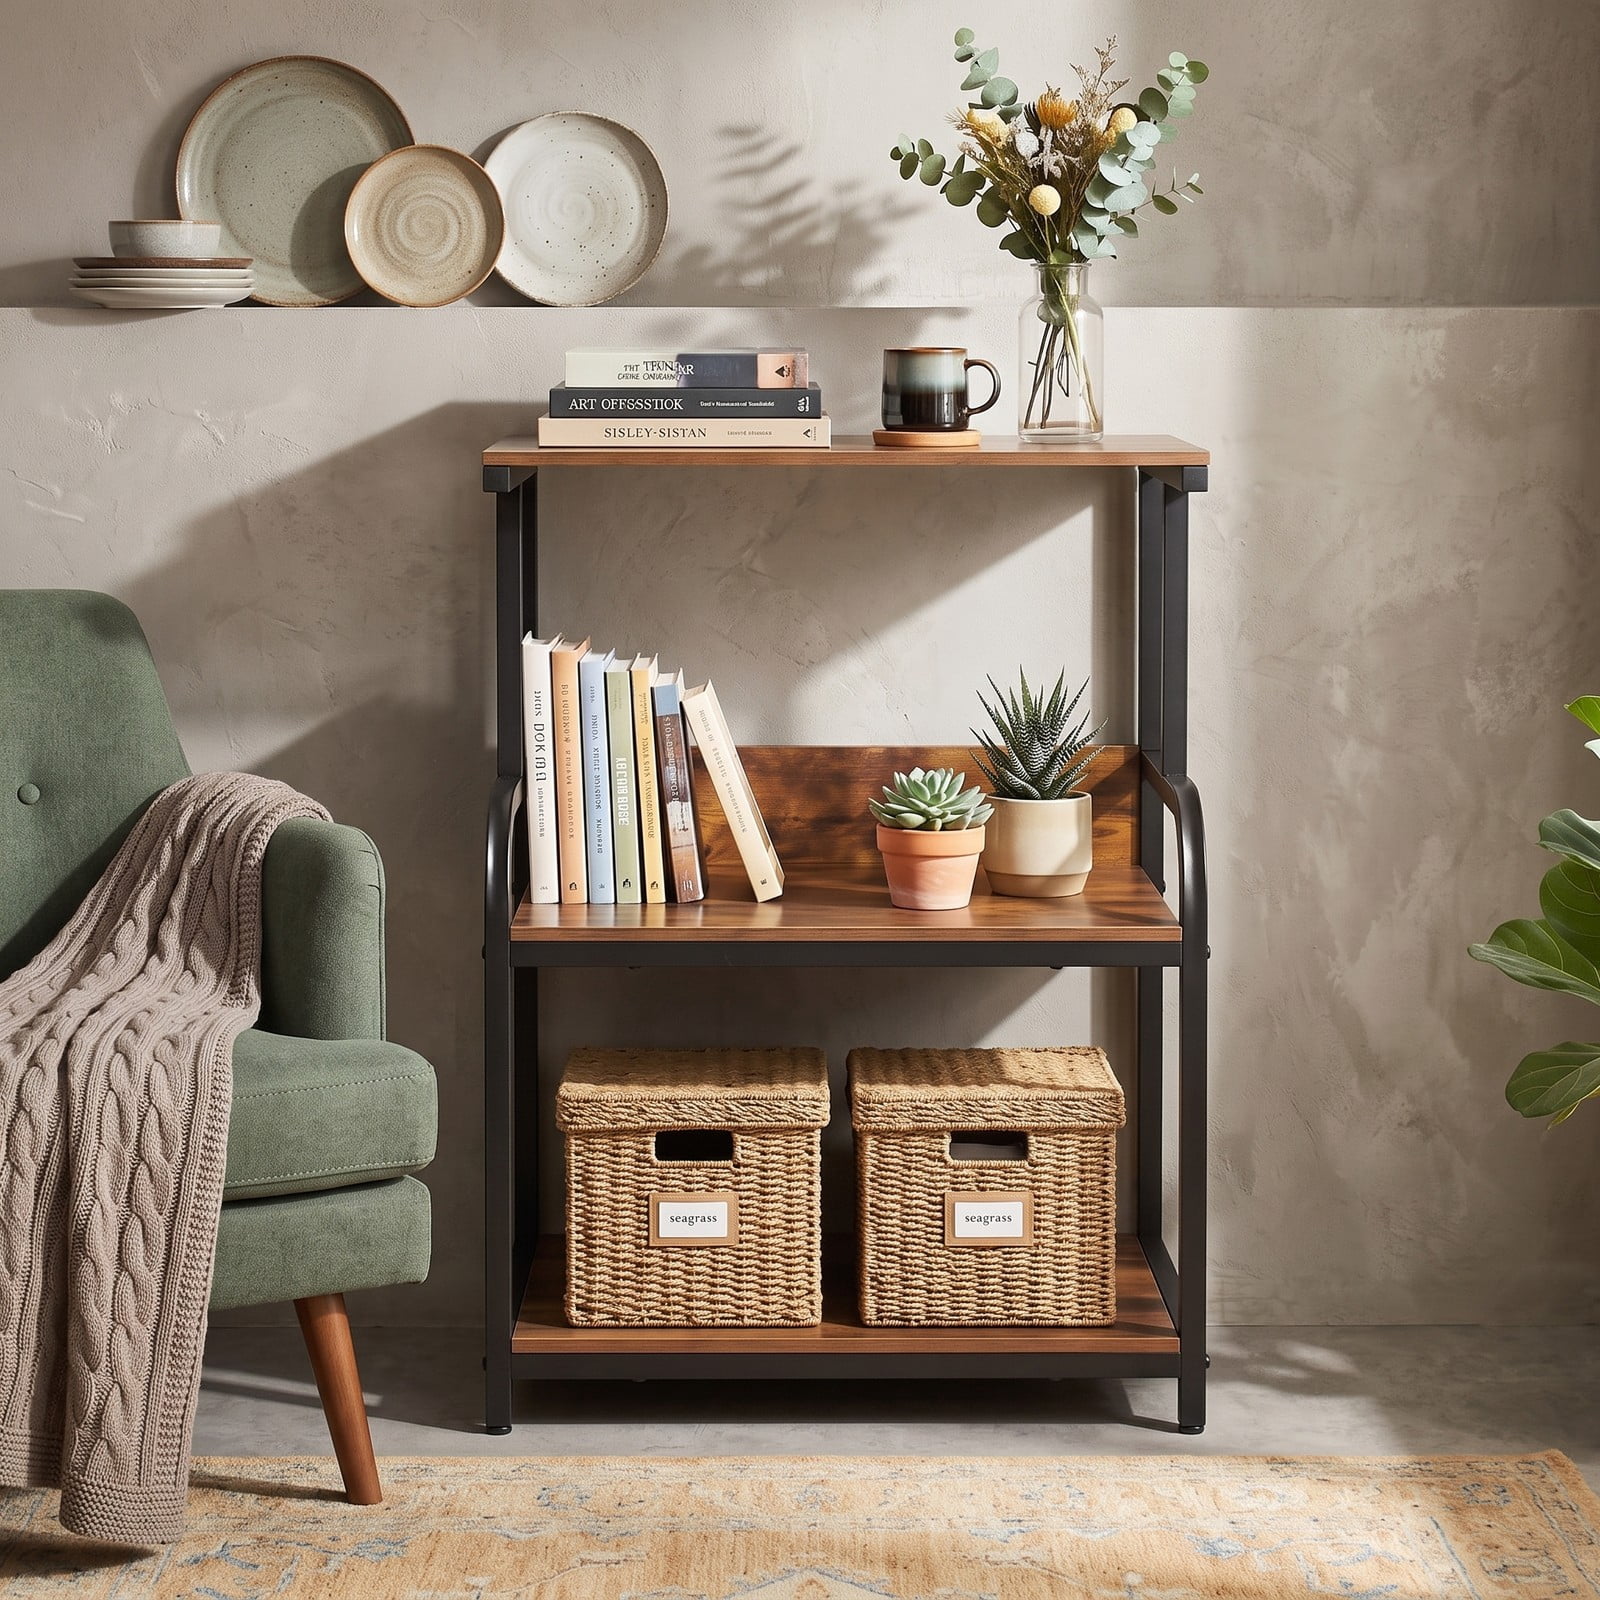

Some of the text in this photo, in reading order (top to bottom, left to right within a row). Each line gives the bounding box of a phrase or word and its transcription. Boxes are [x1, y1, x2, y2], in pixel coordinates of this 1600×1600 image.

[568, 399, 597, 410] ART
[604, 428, 706, 438] SISLEY-SISTAN
[669, 1214, 717, 1226] seagrass
[964, 1214, 1012, 1226] seagrass
